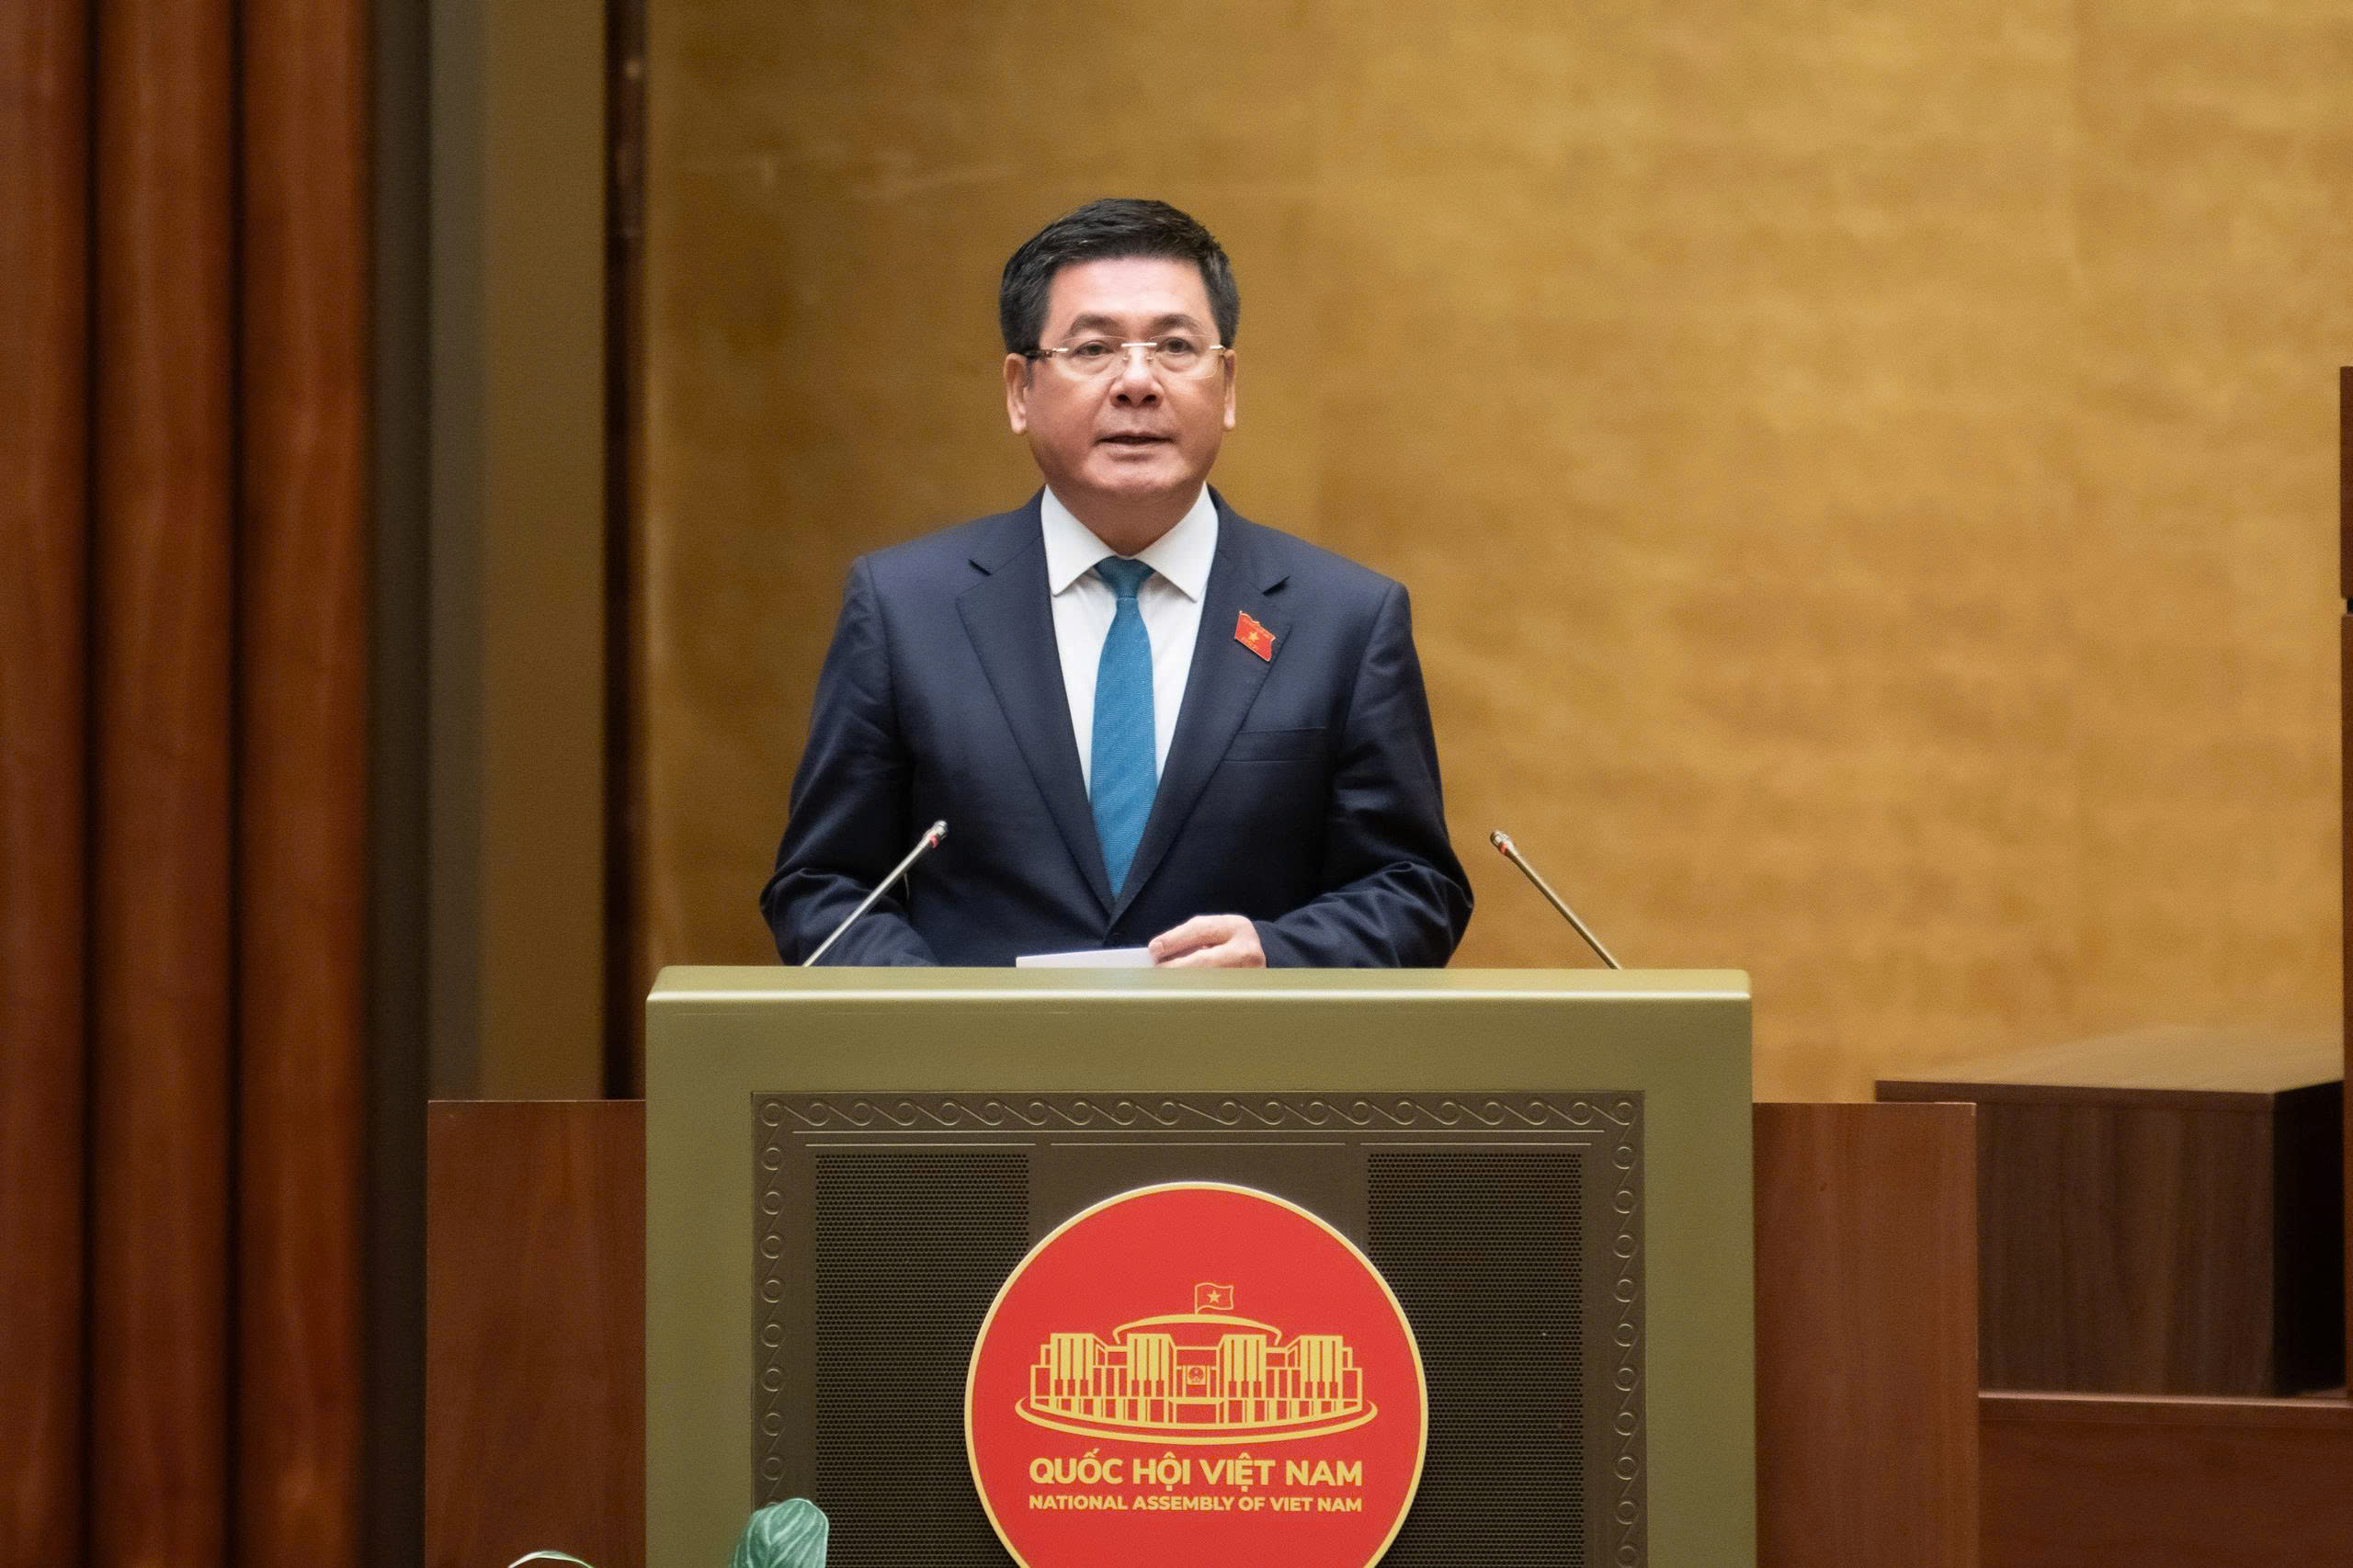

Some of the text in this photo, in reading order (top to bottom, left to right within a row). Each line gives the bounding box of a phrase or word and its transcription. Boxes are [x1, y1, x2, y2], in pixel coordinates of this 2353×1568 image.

[1029, 1448, 1362, 1493] QUỐC HỘI VIỆT NAM
[1029, 1494, 1362, 1512] NATIONAL ASSEMBLY OF VIET NAM
